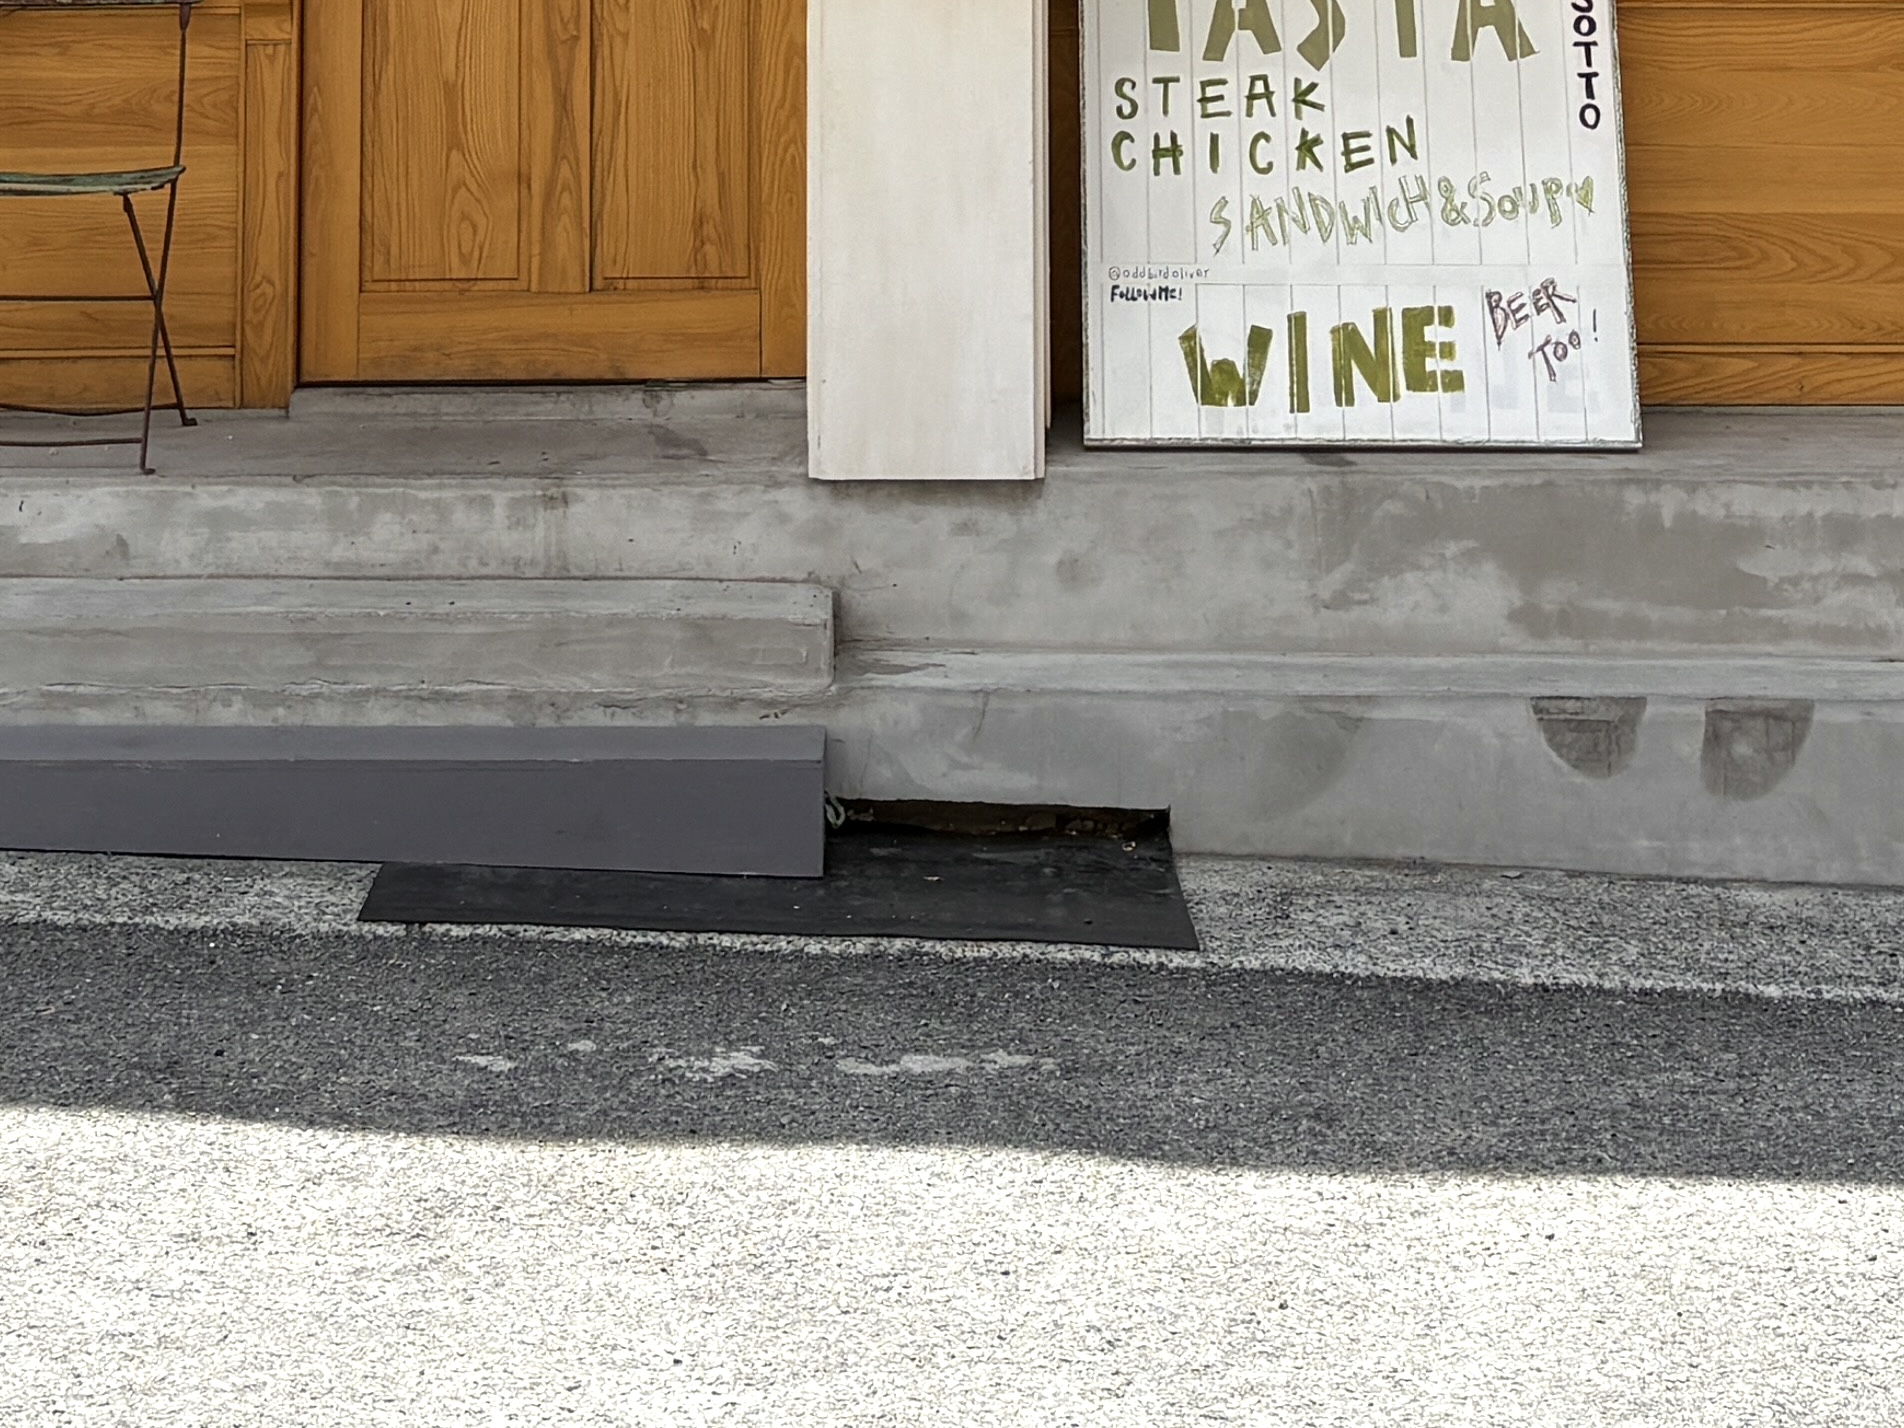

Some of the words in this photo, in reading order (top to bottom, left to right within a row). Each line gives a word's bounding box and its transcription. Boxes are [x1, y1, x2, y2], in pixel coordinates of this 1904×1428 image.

[1115, 74, 1326, 121] STEAK
[1110, 115, 1419, 177] CHICKEN
[1108, 266, 1209, 281] @oddbirdoliver
[1486, 276, 1576, 351] BEER
[1178, 305, 1465, 414] WINE
